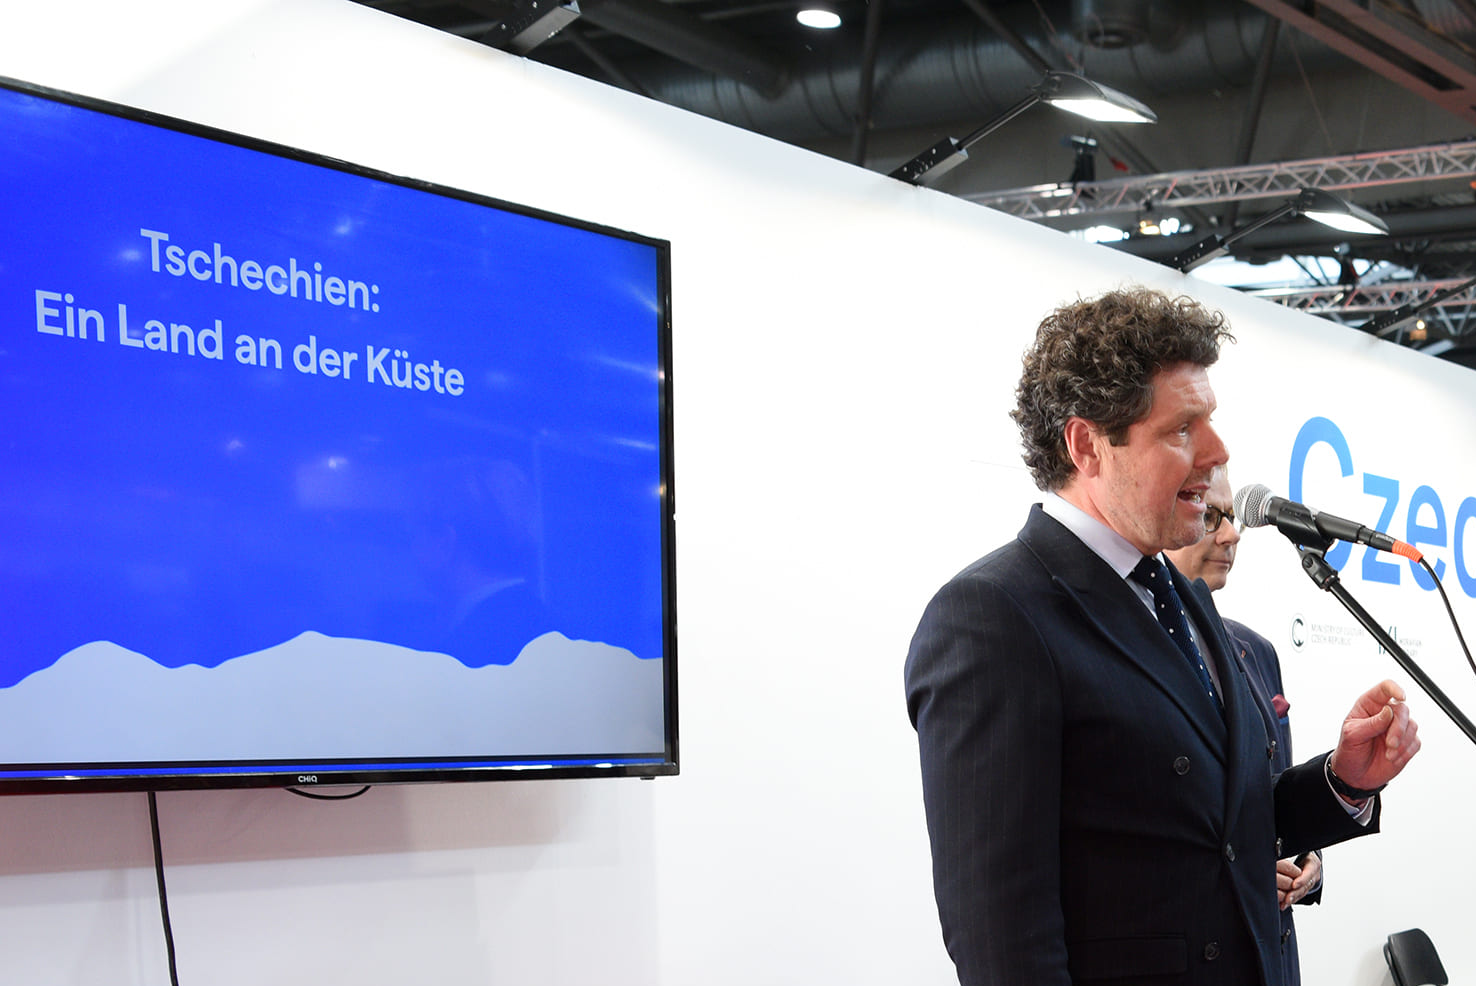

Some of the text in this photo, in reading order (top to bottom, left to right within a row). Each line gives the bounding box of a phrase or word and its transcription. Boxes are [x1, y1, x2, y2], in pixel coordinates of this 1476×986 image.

[139, 228, 380, 313] Tschechien:
[35, 289, 465, 396] Ein Land an der Küste
